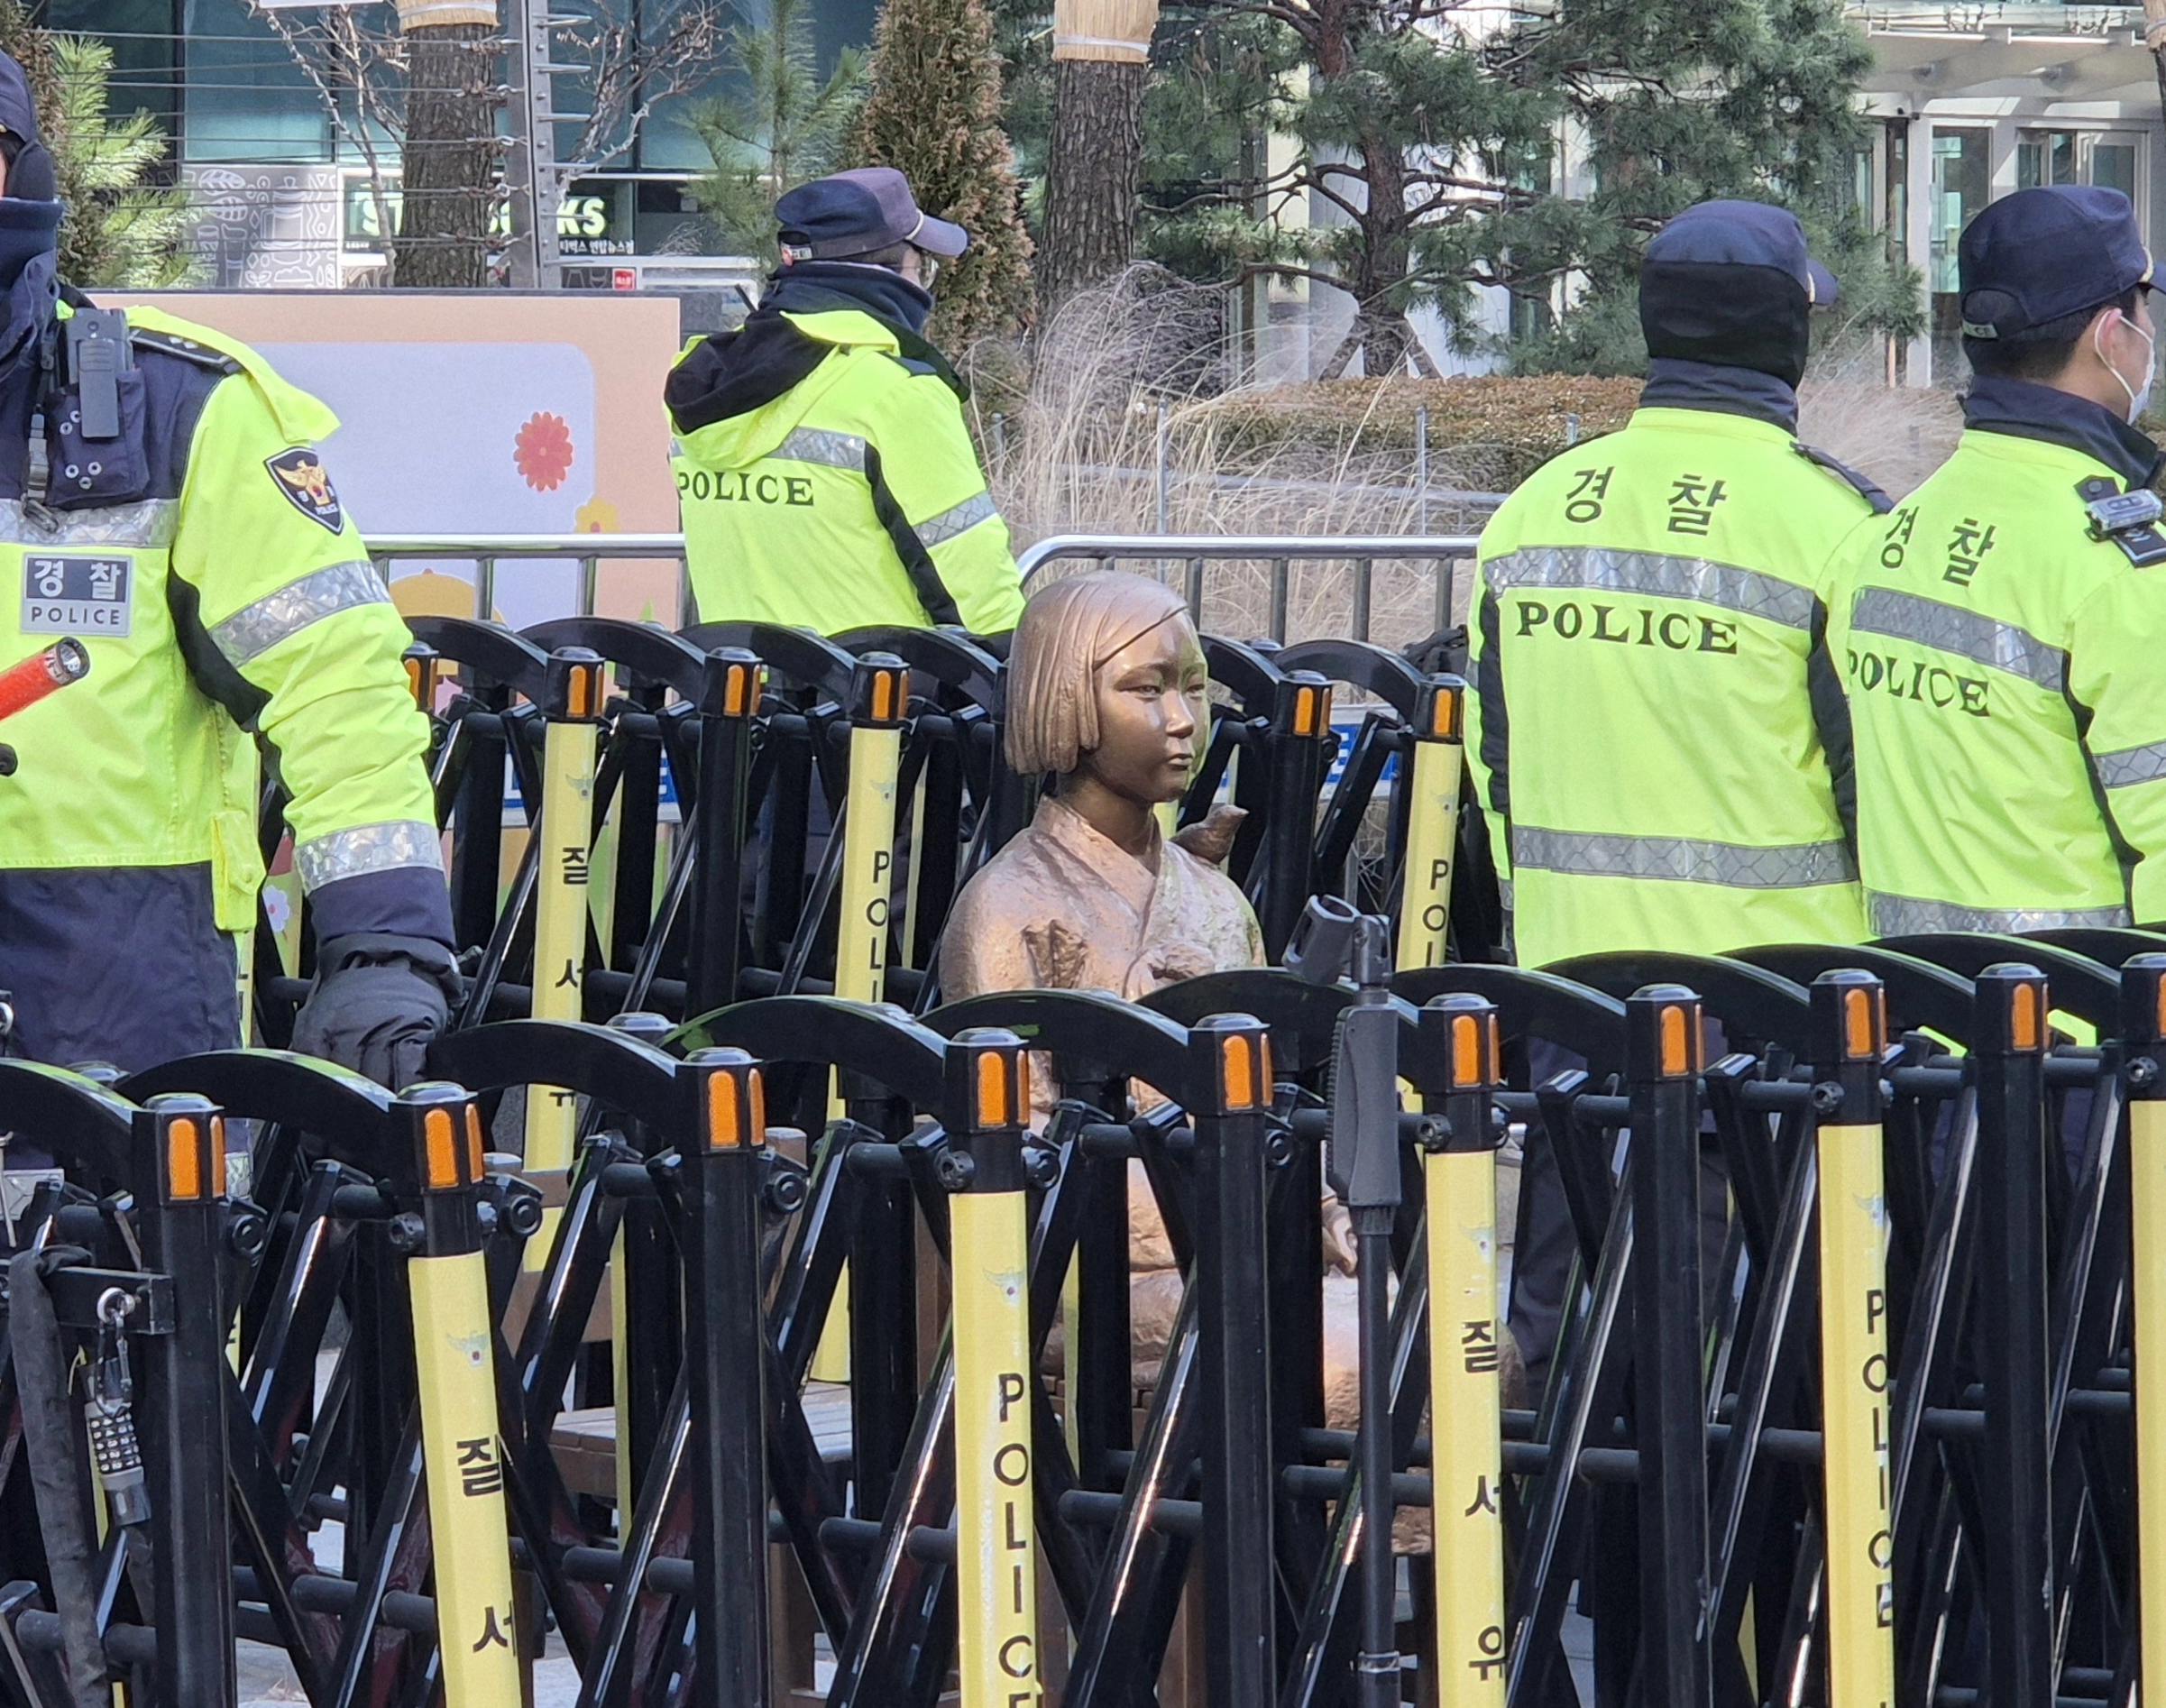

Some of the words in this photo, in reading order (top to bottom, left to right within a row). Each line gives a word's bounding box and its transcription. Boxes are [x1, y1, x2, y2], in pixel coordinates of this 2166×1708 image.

[677, 471, 814, 506] POLICE
[1565, 465, 1728, 536] 경찰
[1880, 506, 1996, 587] 경찰
[34, 560, 123, 600] 경찰
[31, 606, 120, 625] POLICE
[1516, 601, 1738, 655] POLICE
[1847, 648, 1990, 717] POLICE
